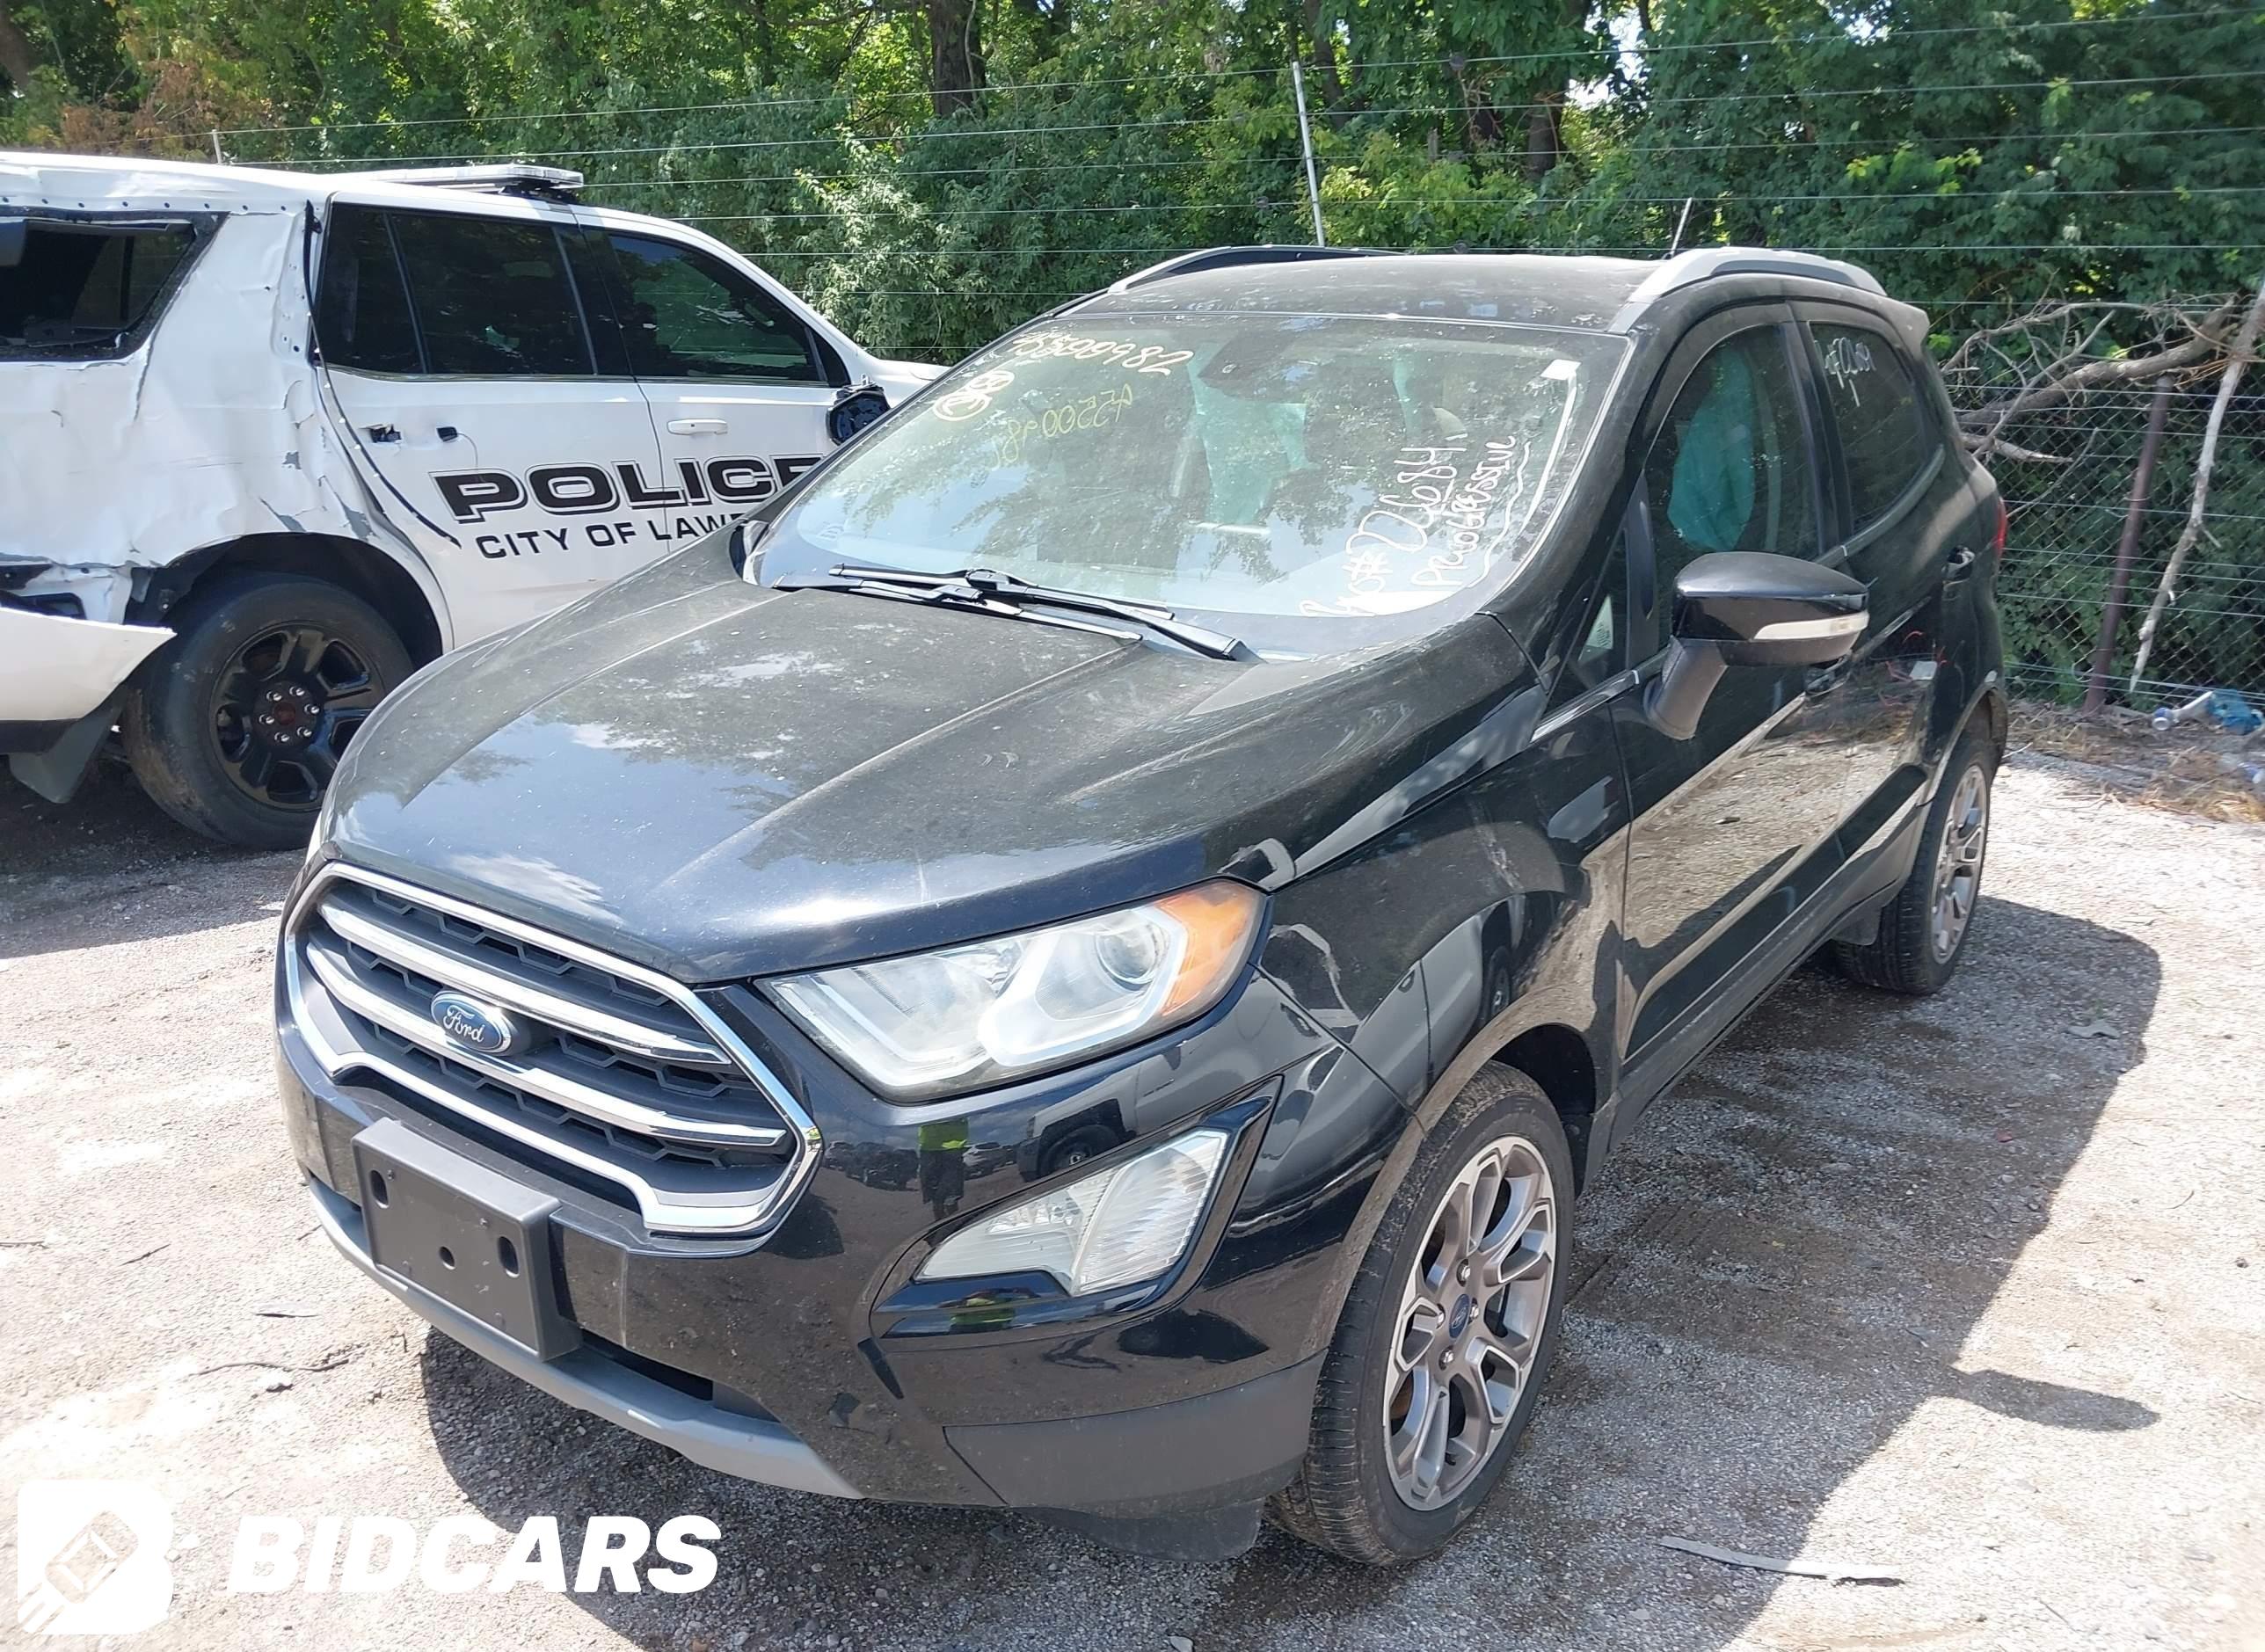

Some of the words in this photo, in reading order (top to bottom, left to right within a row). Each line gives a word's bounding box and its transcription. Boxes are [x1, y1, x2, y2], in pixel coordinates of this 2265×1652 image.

[476, 528, 569, 559] CITY
[586, 522, 637, 547] OF
[646, 513, 747, 541] LAW
[443, 1005, 485, 1043] Ford
